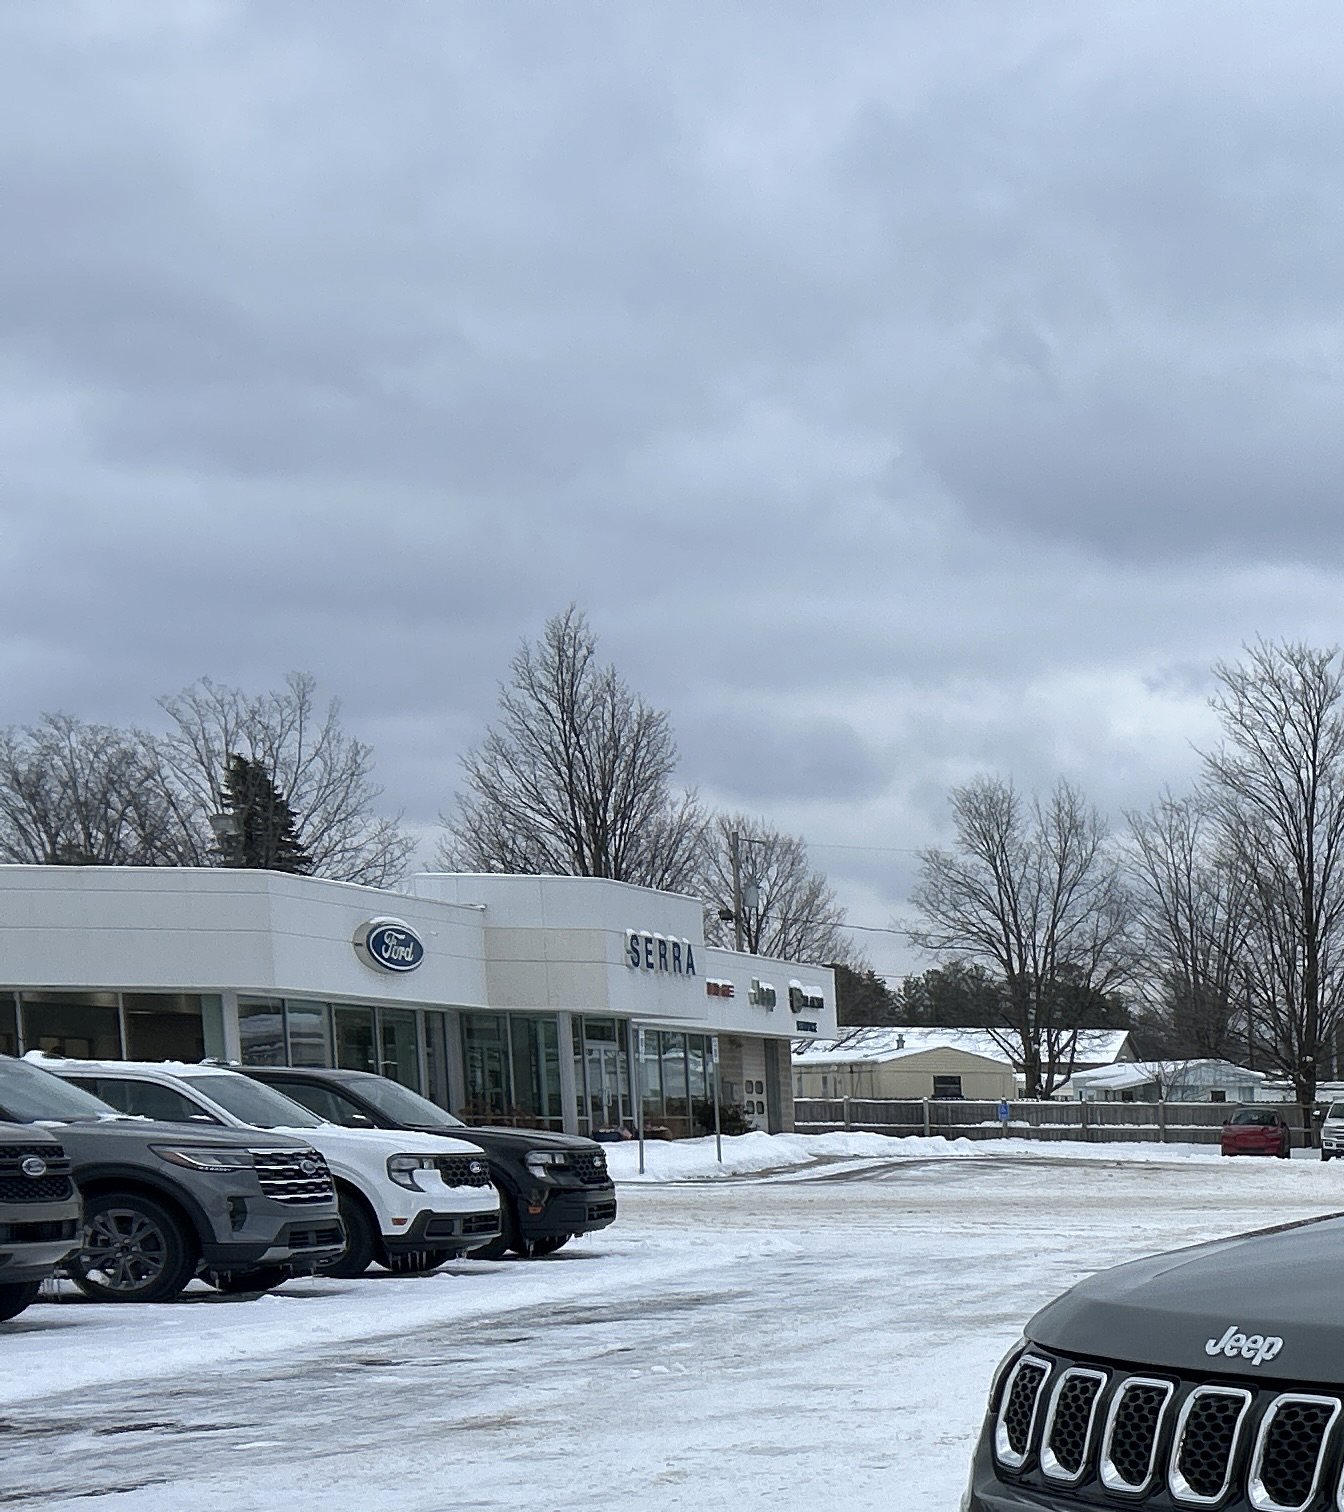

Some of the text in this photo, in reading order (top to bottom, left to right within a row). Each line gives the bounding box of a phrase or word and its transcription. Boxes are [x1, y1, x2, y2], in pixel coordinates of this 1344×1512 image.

[381, 930, 414, 962] Ford
[630, 934, 696, 976] SERRA
[1205, 1325, 1284, 1366] Jeep
